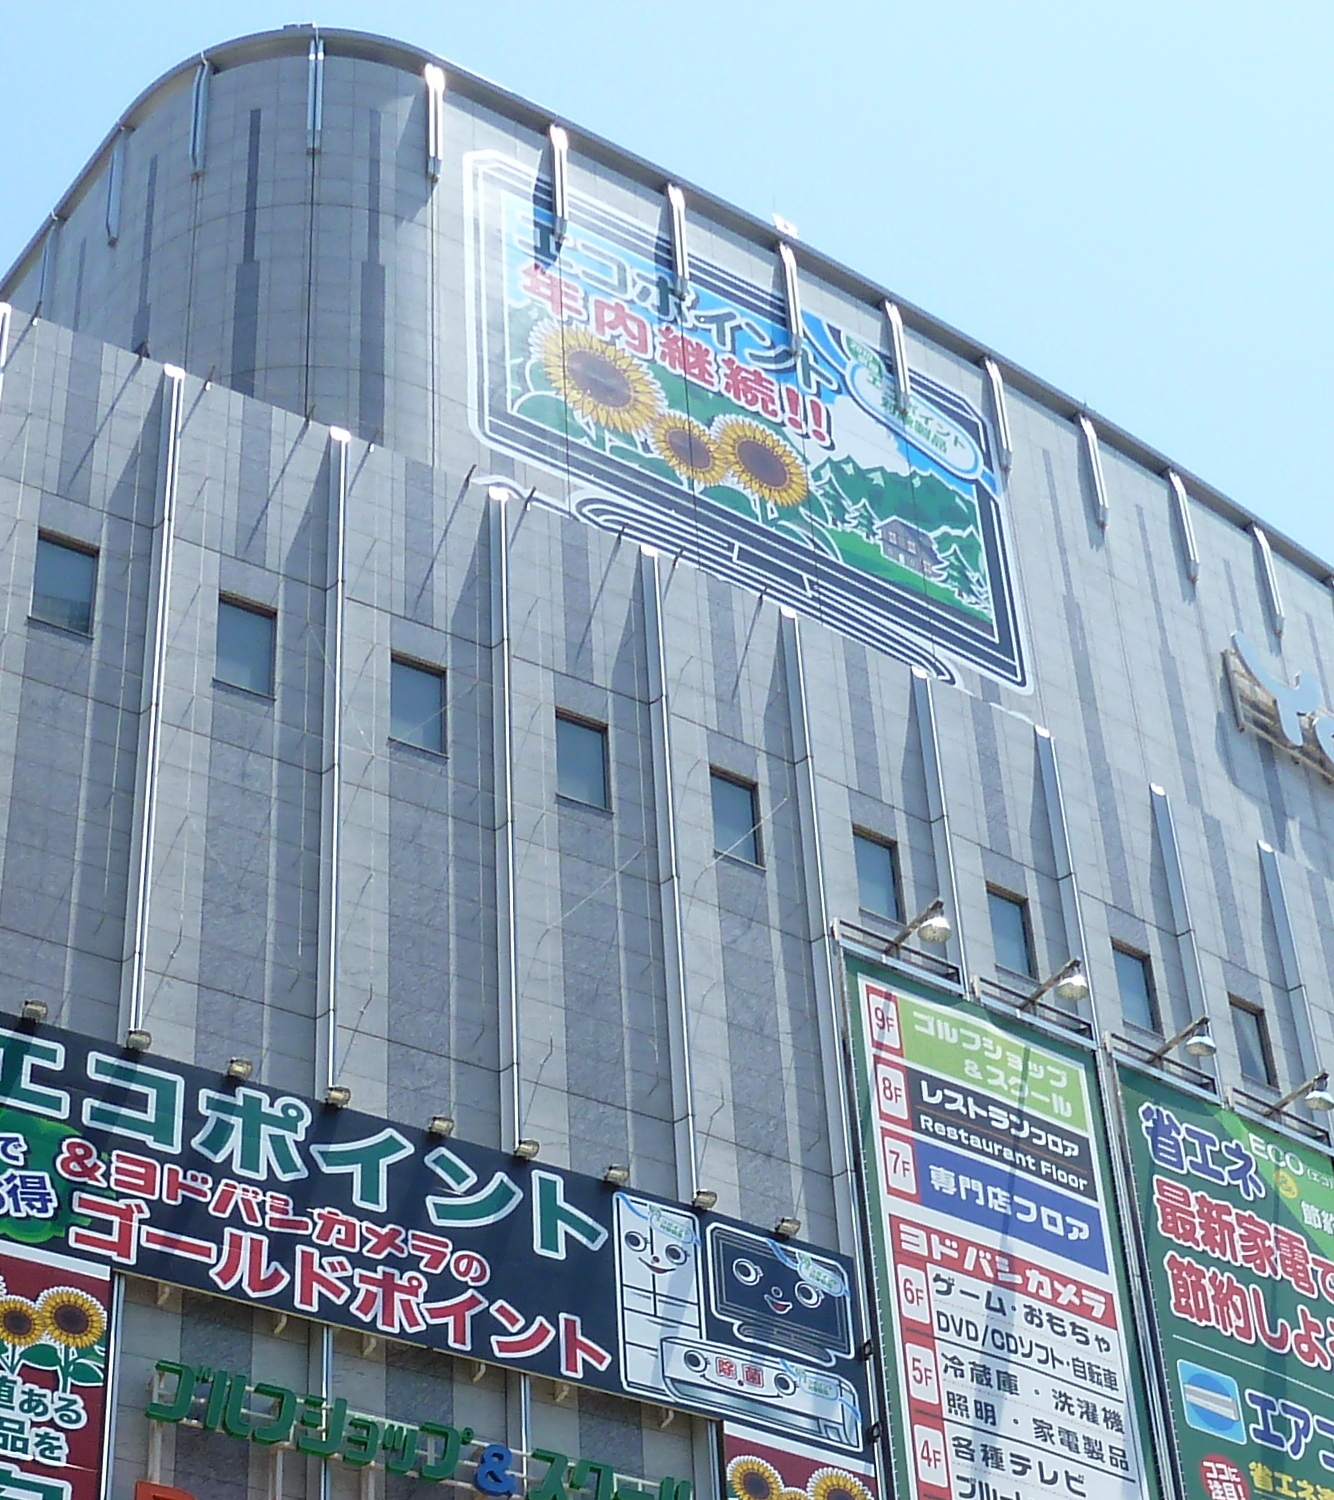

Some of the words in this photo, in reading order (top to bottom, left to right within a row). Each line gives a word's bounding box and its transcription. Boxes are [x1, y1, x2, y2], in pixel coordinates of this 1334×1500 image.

[874, 1006, 895, 1033] 9F
[912, 1010, 1069, 1089] ゴルフショップ
[882, 1076, 903, 1104] 8F
[920, 1080, 1080, 1158] レストランフロア
[889, 1150, 911, 1178] 7F
[919, 1114, 1037, 1173] Restaurant
[1040, 1160, 1088, 1193] Floor
[1138, 1101, 1265, 1200] 省エネ
[928, 1165, 1090, 1241] 専門店フロア
[66, 1191, 615, 1379] ゴールドポイント
[898, 1223, 1107, 1319] ヨドバシカメラ
[902, 1277, 925, 1308] 6F
[911, 1359, 934, 1389] 5F
[920, 1439, 942, 1470] 4F
[951, 1436, 1087, 1499] 各種テレビ
